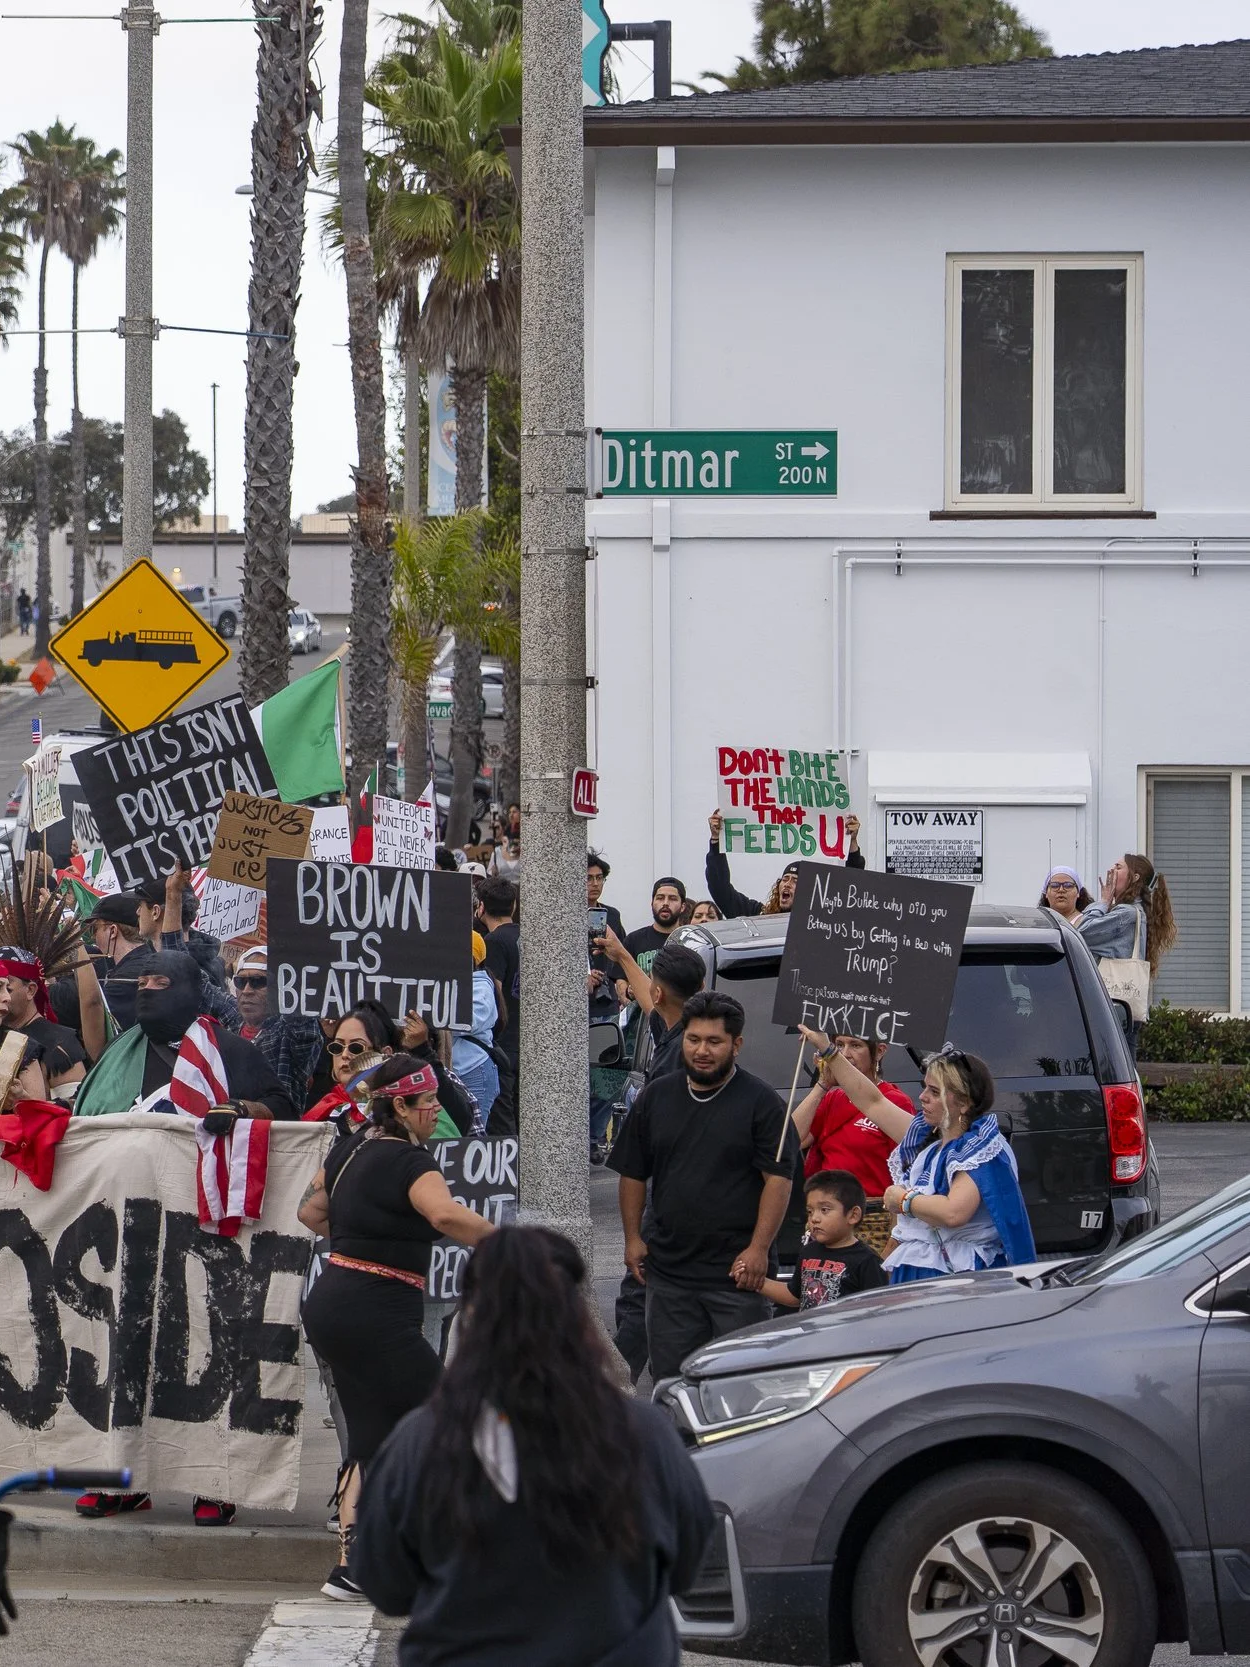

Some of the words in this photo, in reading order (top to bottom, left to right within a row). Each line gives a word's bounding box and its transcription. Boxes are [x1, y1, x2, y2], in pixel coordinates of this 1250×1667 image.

[602, 438, 740, 489] Ditmar
[775, 442, 794, 460] ST
[778, 466, 812, 484] 200
[816, 466, 827, 484] N
[93, 724, 182, 784] THIS
[176, 697, 246, 758] ISN'T
[116, 752, 279, 838] POLITICAL
[576, 778, 597, 807] ALL
[724, 777, 776, 806] THE
[375, 796, 394, 813] THE
[399, 802, 431, 823] PEOPLE
[381, 814, 418, 834] UNITED
[890, 812, 928, 826] TOW
[932, 812, 978, 826] AWAY
[243, 825, 272, 840] NOT
[310, 827, 348, 841] ORANCE
[374, 828, 397, 847] WILL
[399, 833, 427, 854] NEVER
[724, 818, 817, 857] FEEDS
[111, 829, 181, 888] IT'S
[218, 837, 269, 858] JUST
[377, 847, 389, 863] BE
[394, 849, 435, 870] DEFEATED
[200, 888, 241, 918] Illegal
[245, 890, 258, 903] on
[296, 861, 430, 932] BROWN
[883, 896, 903, 920] why
[931, 906, 948, 923] you
[234, 904, 258, 932] Land
[329, 931, 382, 974] IS
[851, 921, 866, 950] by
[902, 934, 911, 947] in
[933, 939, 952, 957] with
[277, 962, 472, 1031] BEAUTIFUL
[463, 1139, 519, 1188] OUR
[1084, 1212, 1102, 1228] 17
